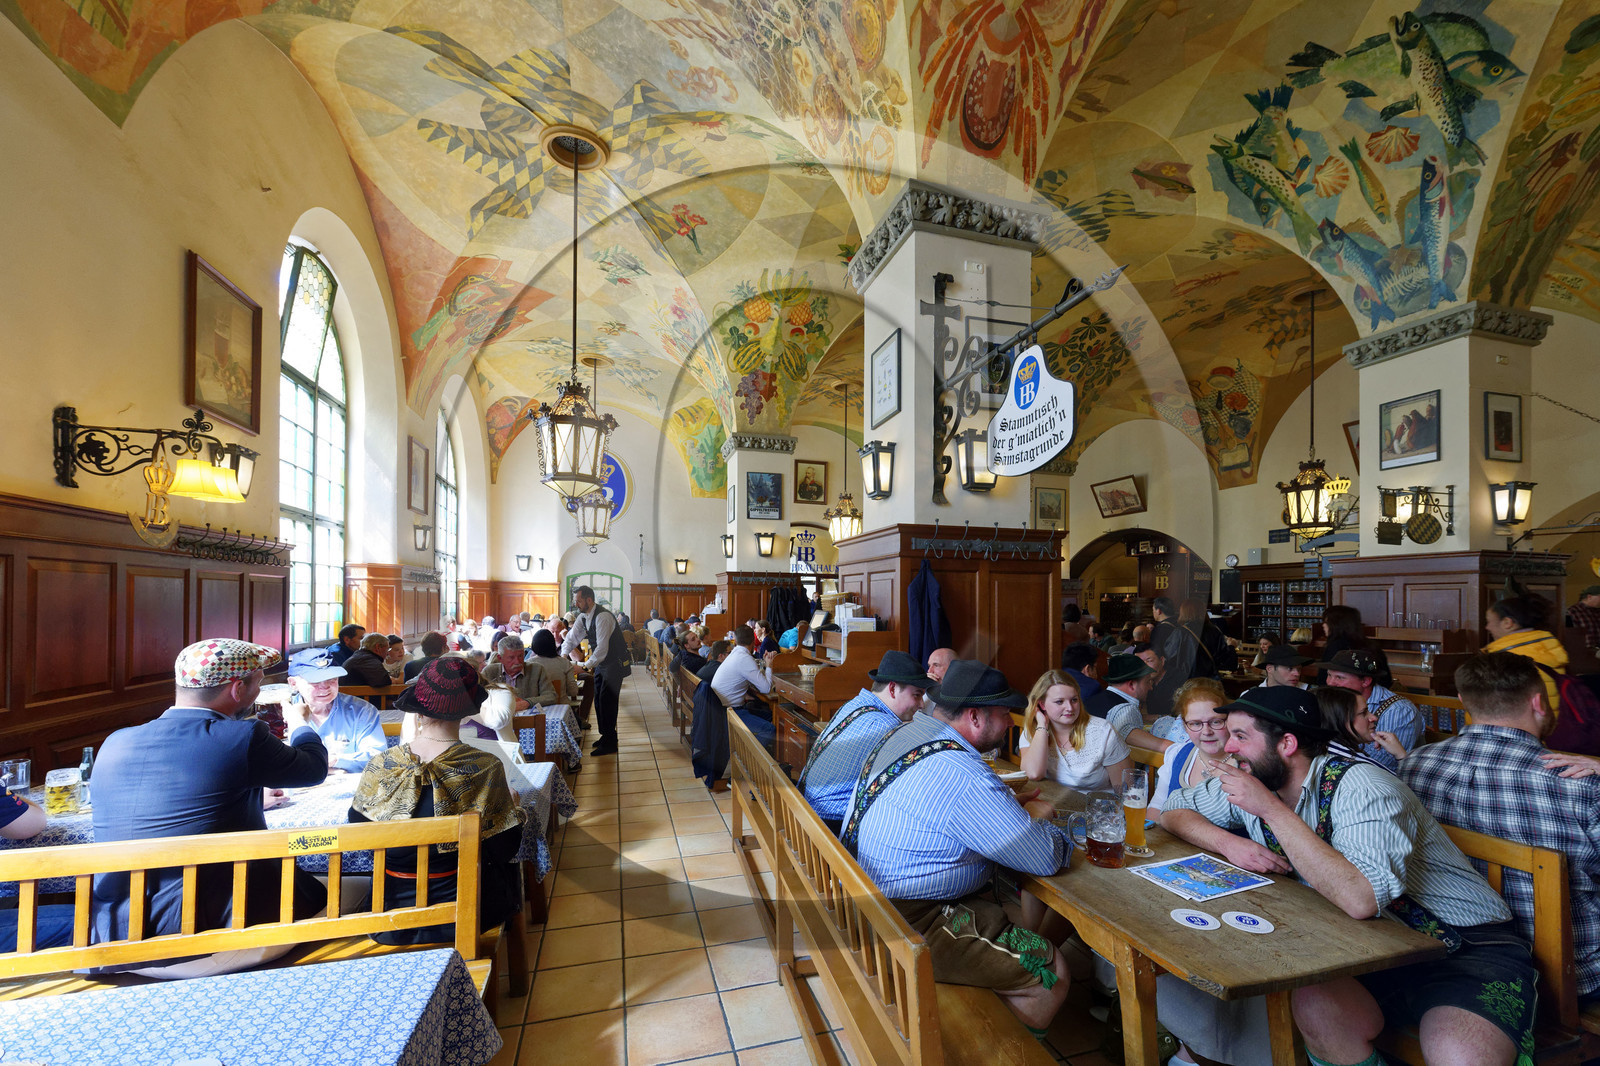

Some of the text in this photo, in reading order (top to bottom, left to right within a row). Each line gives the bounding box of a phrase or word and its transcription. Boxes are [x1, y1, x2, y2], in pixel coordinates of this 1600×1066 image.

[1019, 381, 1036, 408] HB
[999, 394, 1058, 432] Stammtisch
[992, 435, 1006, 450] der
[797, 546, 816, 562] HB
[1155, 575, 1169, 590] HB
